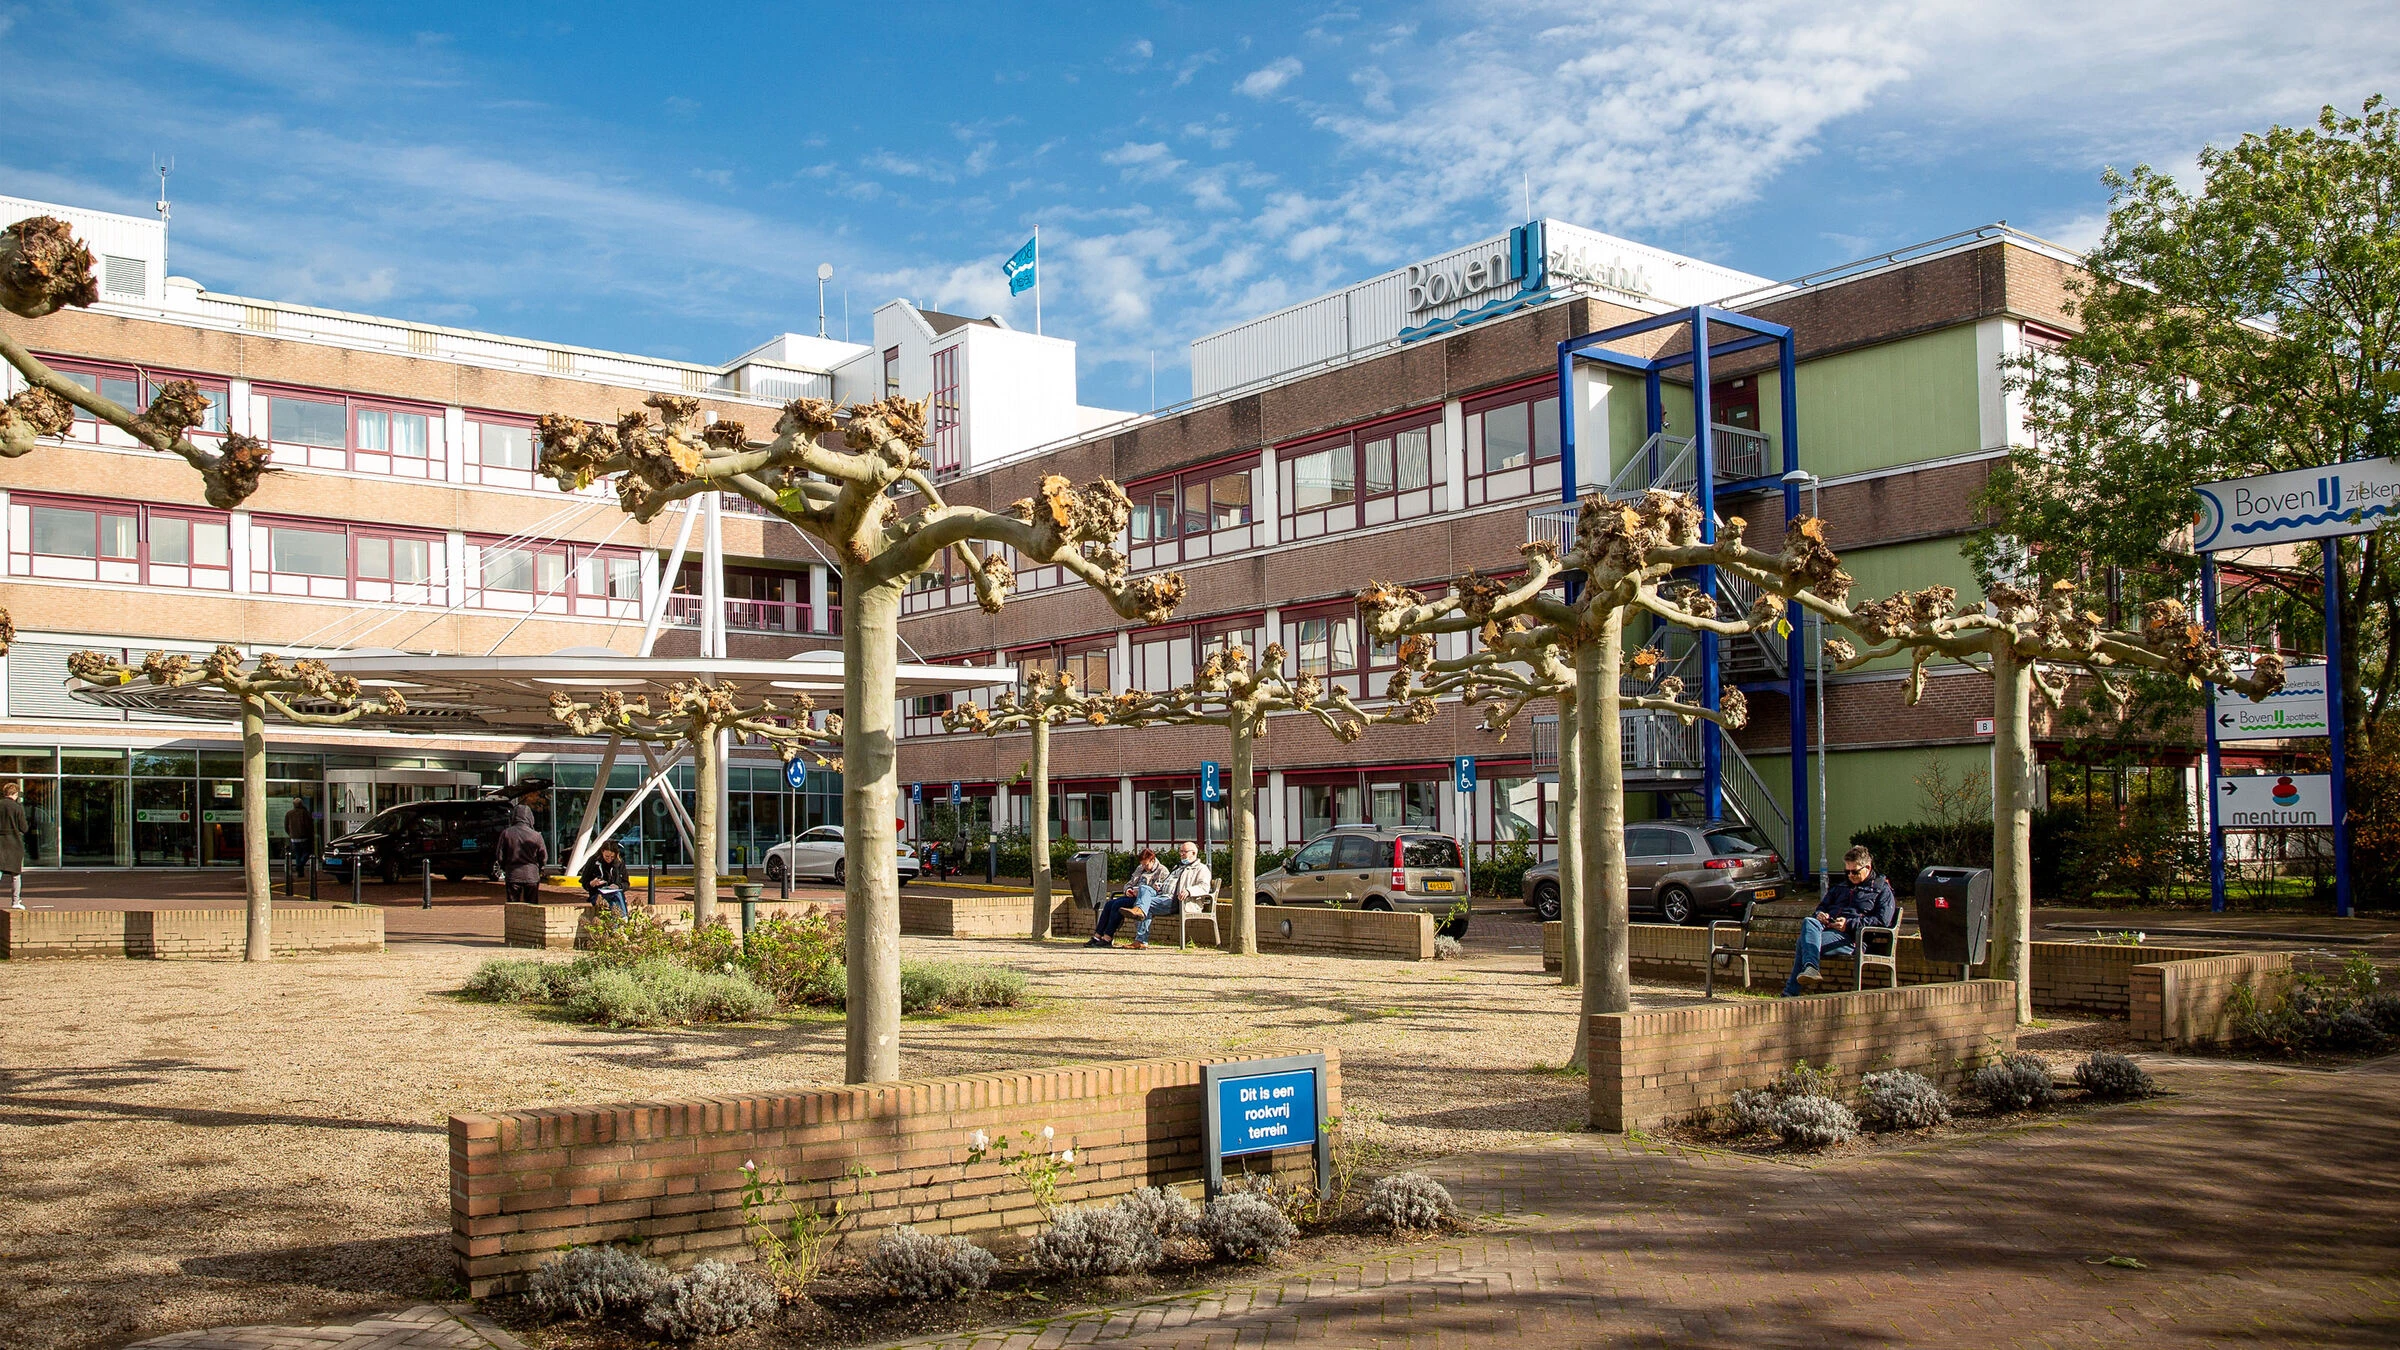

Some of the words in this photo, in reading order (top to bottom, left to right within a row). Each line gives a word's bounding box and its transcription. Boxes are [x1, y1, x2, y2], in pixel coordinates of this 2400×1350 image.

[2236, 476, 2340, 516] BovenIJ
[2240, 710, 2284, 724] BovenIJ
[2286, 712, 2320, 722] apotheek
[1982, 722, 1988, 731] B
[1207, 765, 1215, 778] P
[1462, 759, 1470, 771] P
[914, 784, 920, 795] P
[954, 784, 960, 795] P
[2233, 809, 2317, 825] mentrum
[1240, 1087, 1257, 1102] Dit
[1259, 1086, 1270, 1100] is
[1272, 1086, 1294, 1098] een
[1245, 1102, 1289, 1120] rookvrij
[1248, 1122, 1288, 1139] terrein
